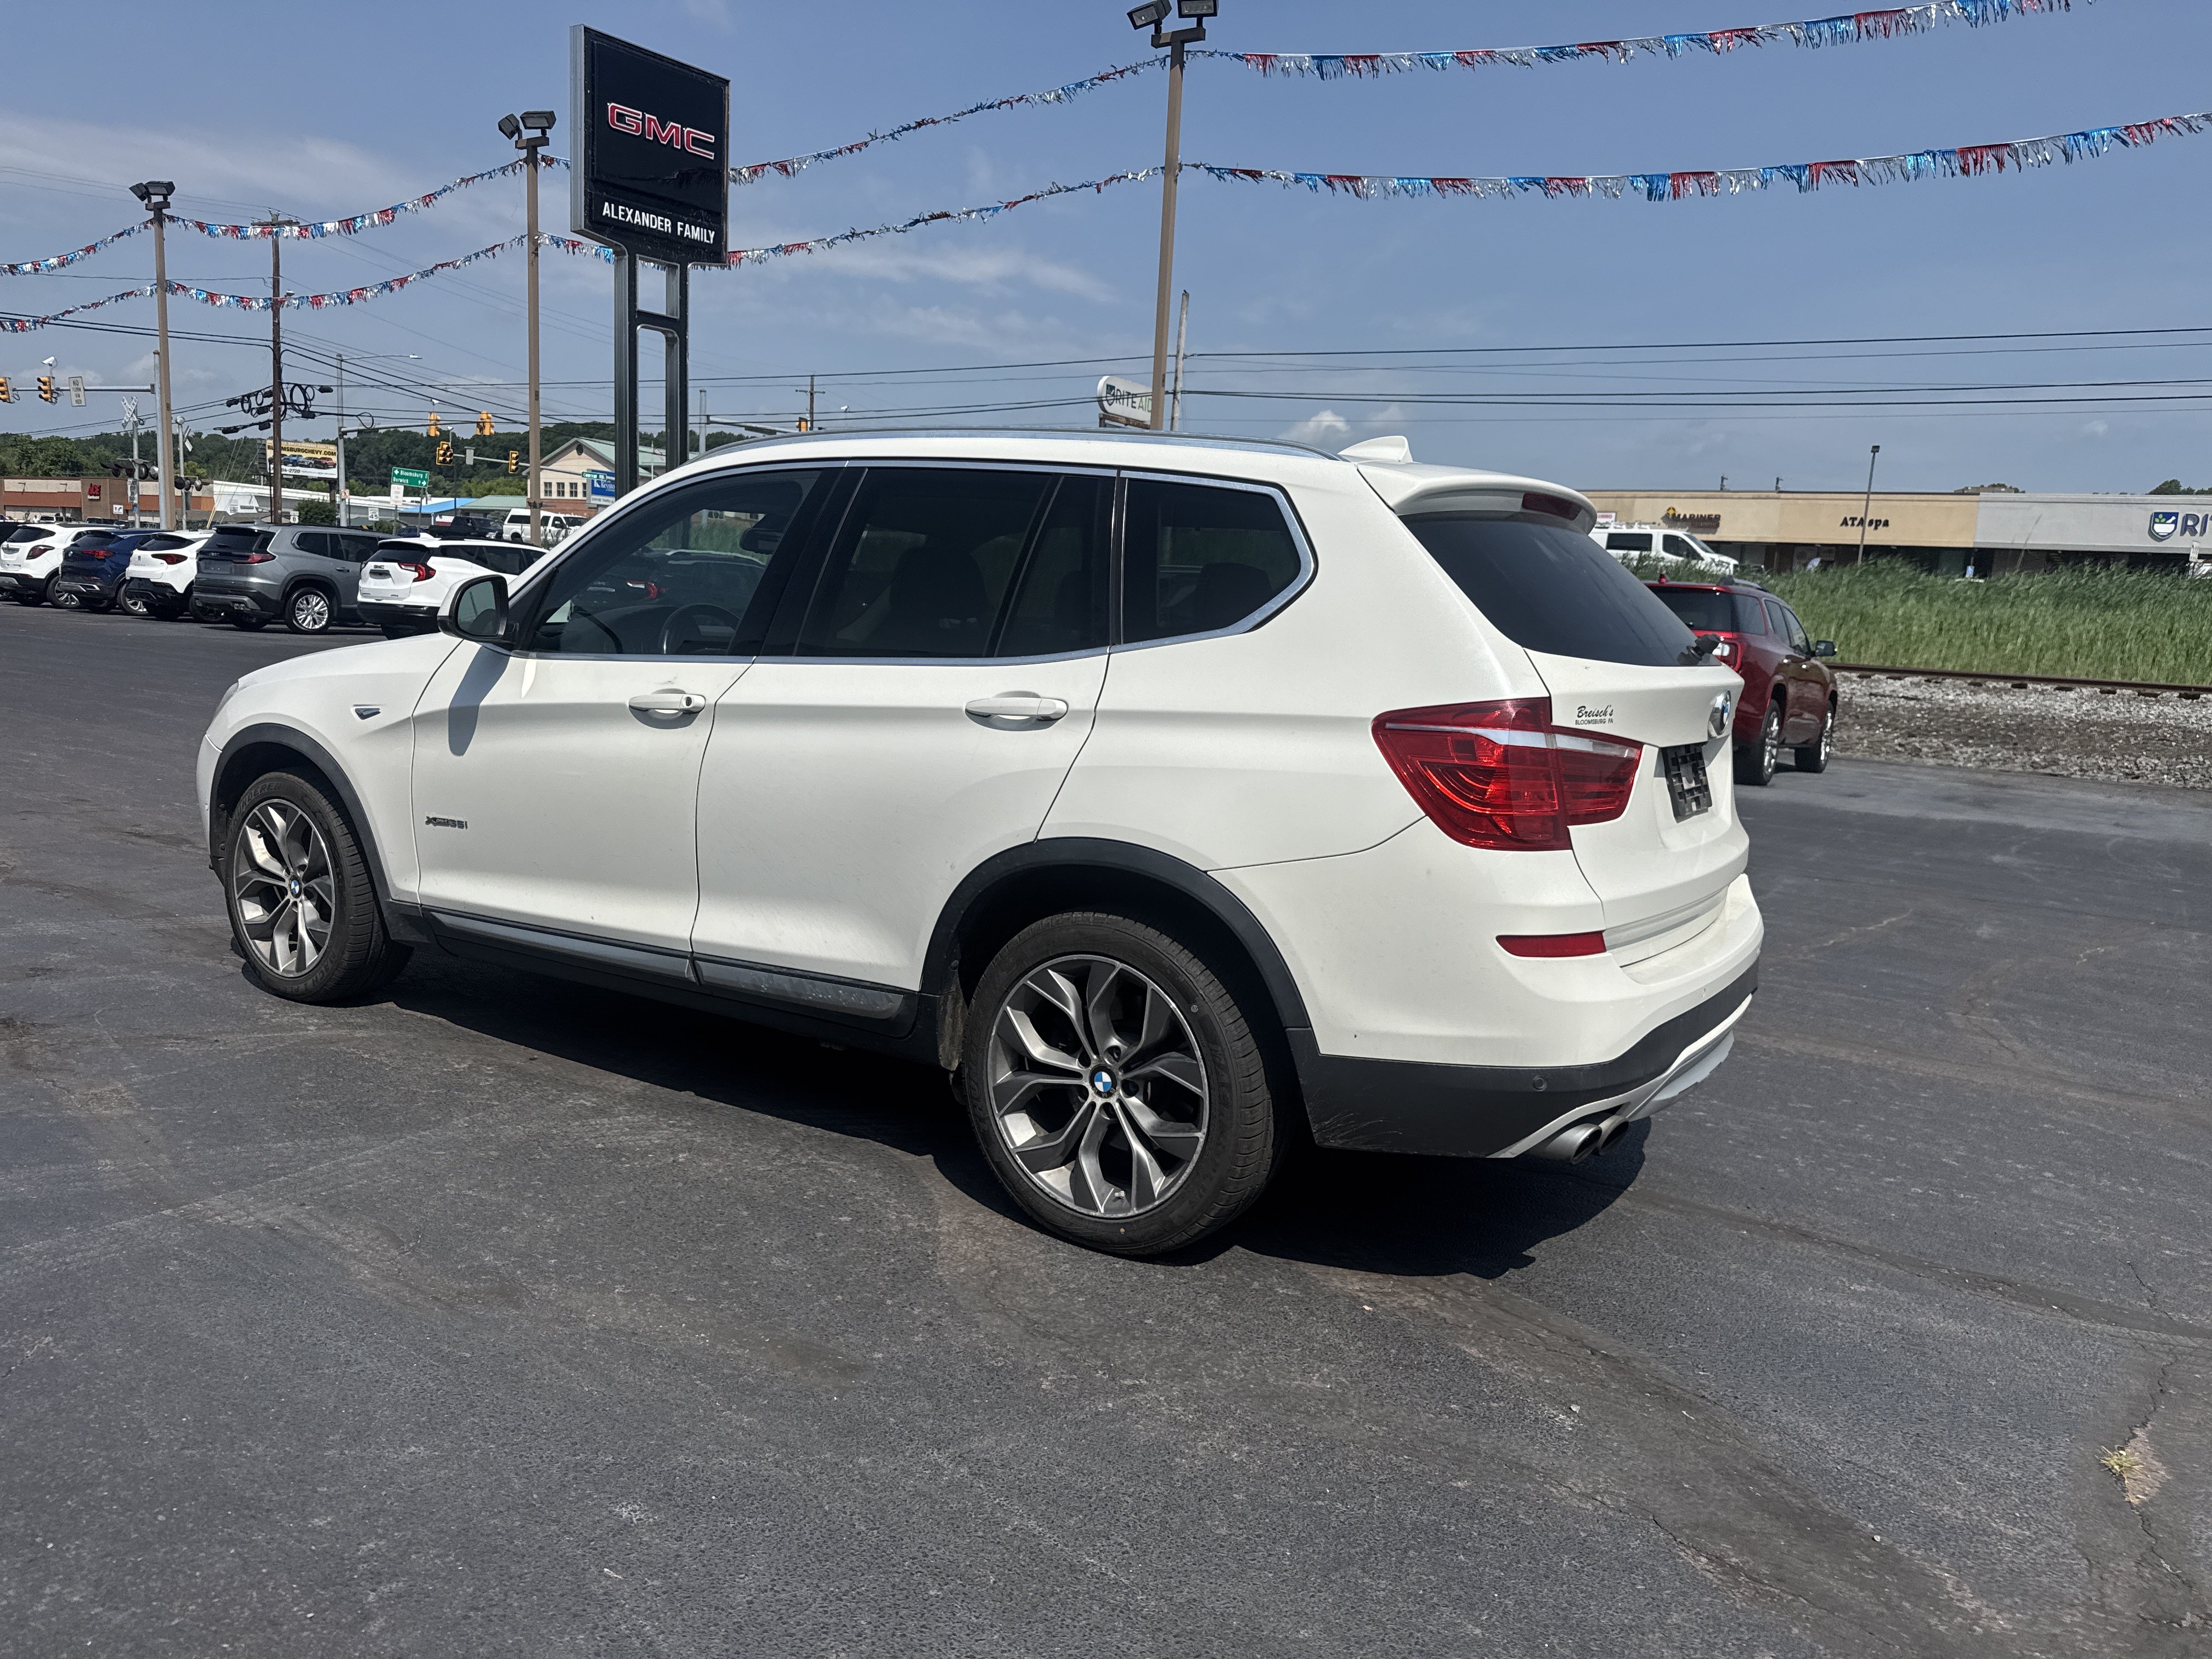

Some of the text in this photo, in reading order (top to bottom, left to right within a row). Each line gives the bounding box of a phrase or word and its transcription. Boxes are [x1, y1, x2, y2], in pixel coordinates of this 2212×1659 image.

[608, 101, 715, 160] GMC
[602, 201, 715, 245] ALEXANDER FAMILY
[1116, 388, 1137, 409] RITE
[268, 445, 336, 456] BLMSBURGCHEVY.COM
[88, 483, 101, 495] ACE
[1839, 517, 1889, 531] ATA spa
[1577, 704, 1613, 718] Breisch's
